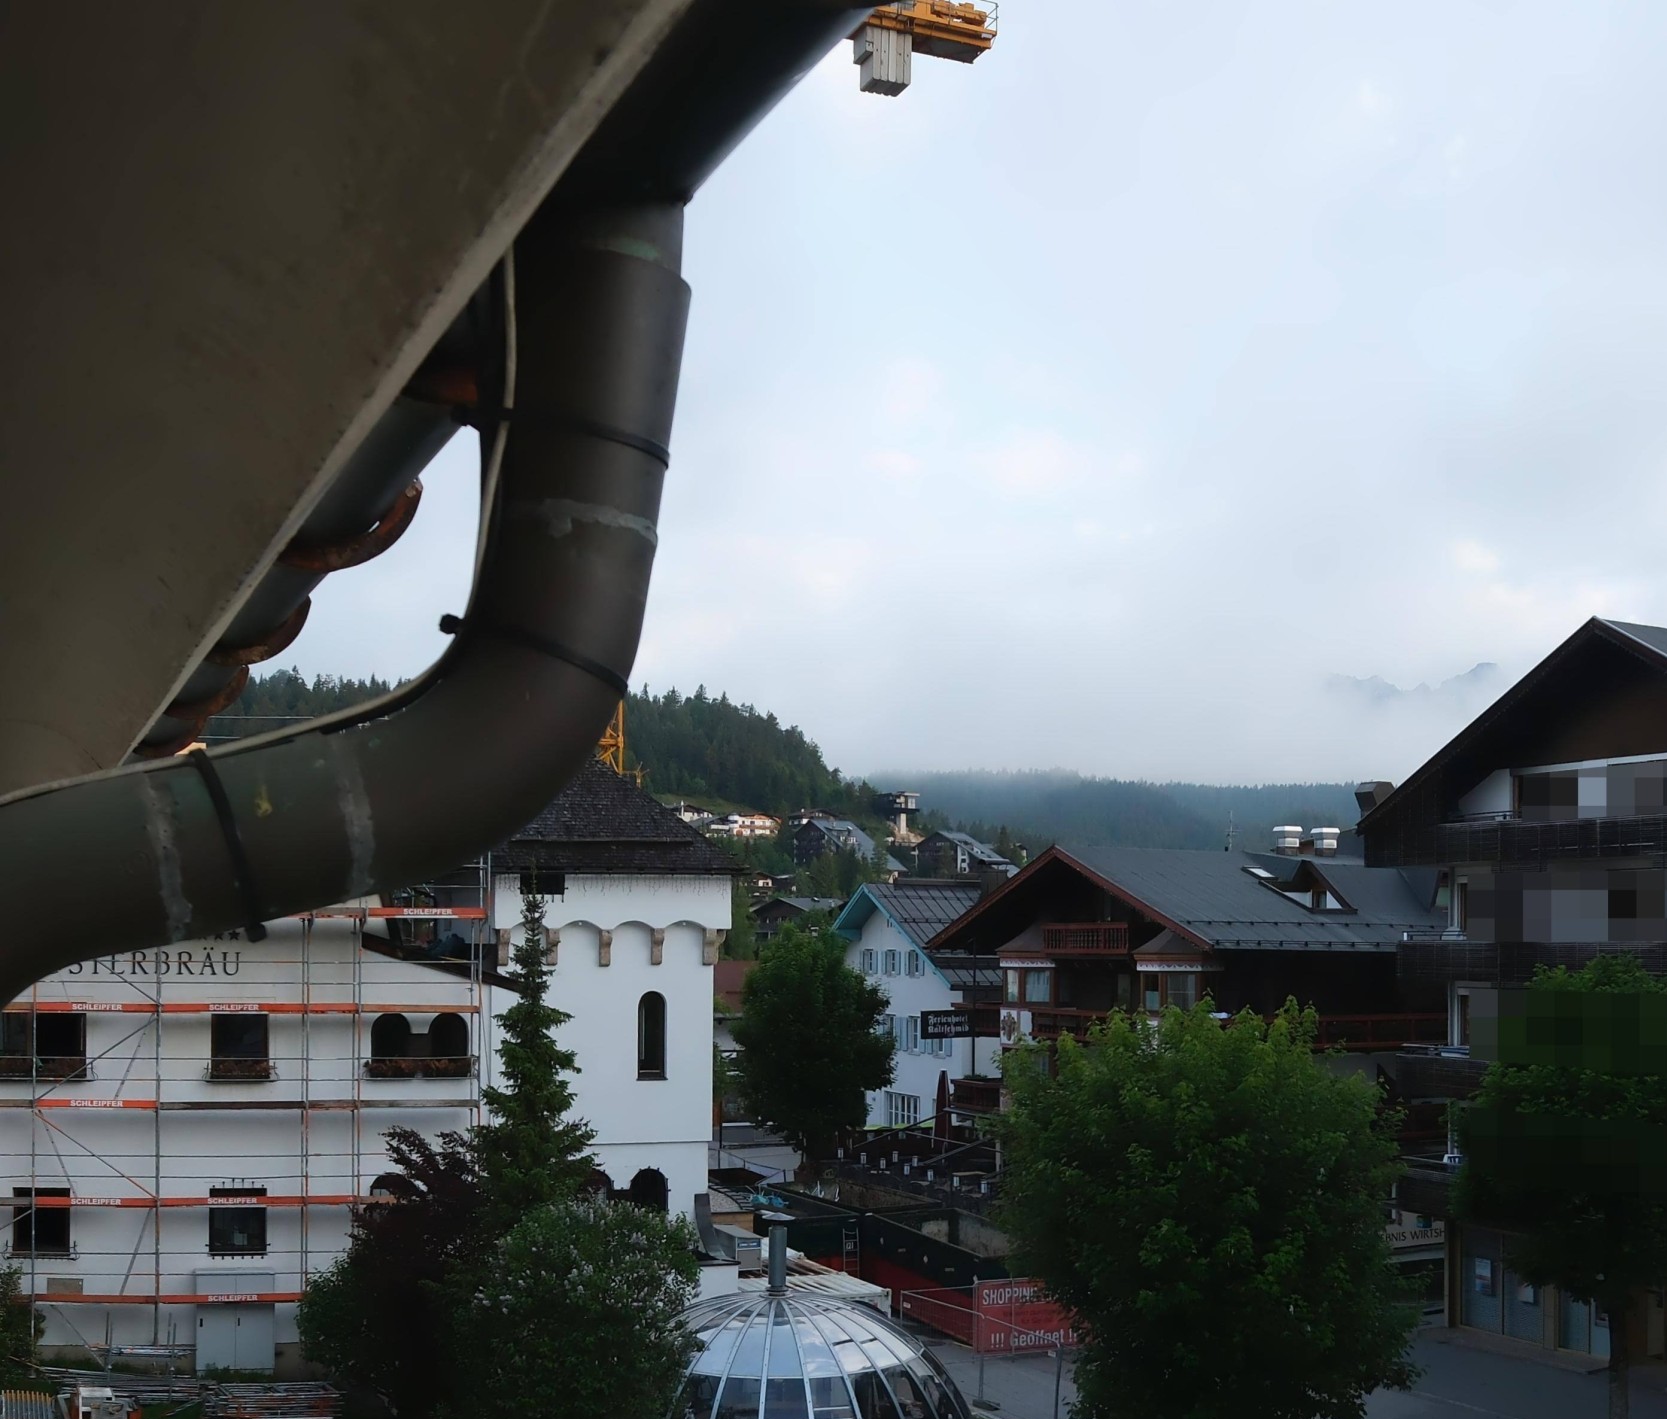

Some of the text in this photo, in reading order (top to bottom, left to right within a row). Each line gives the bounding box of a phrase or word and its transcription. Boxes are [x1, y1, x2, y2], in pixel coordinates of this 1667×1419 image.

[403, 908, 453, 916] SCHLEIPFER
[72, 1003, 123, 1011] SCHLEIPFER
[70, 1100, 124, 1108] SCHLEIPFER
[71, 1198, 121, 1206] SCHLEIPFER
[208, 1197, 257, 1205] SCHLEIPFER
[208, 1294, 258, 1302] SCHLEIPFER
[1010, 1328, 1064, 1346] Geöffnet
